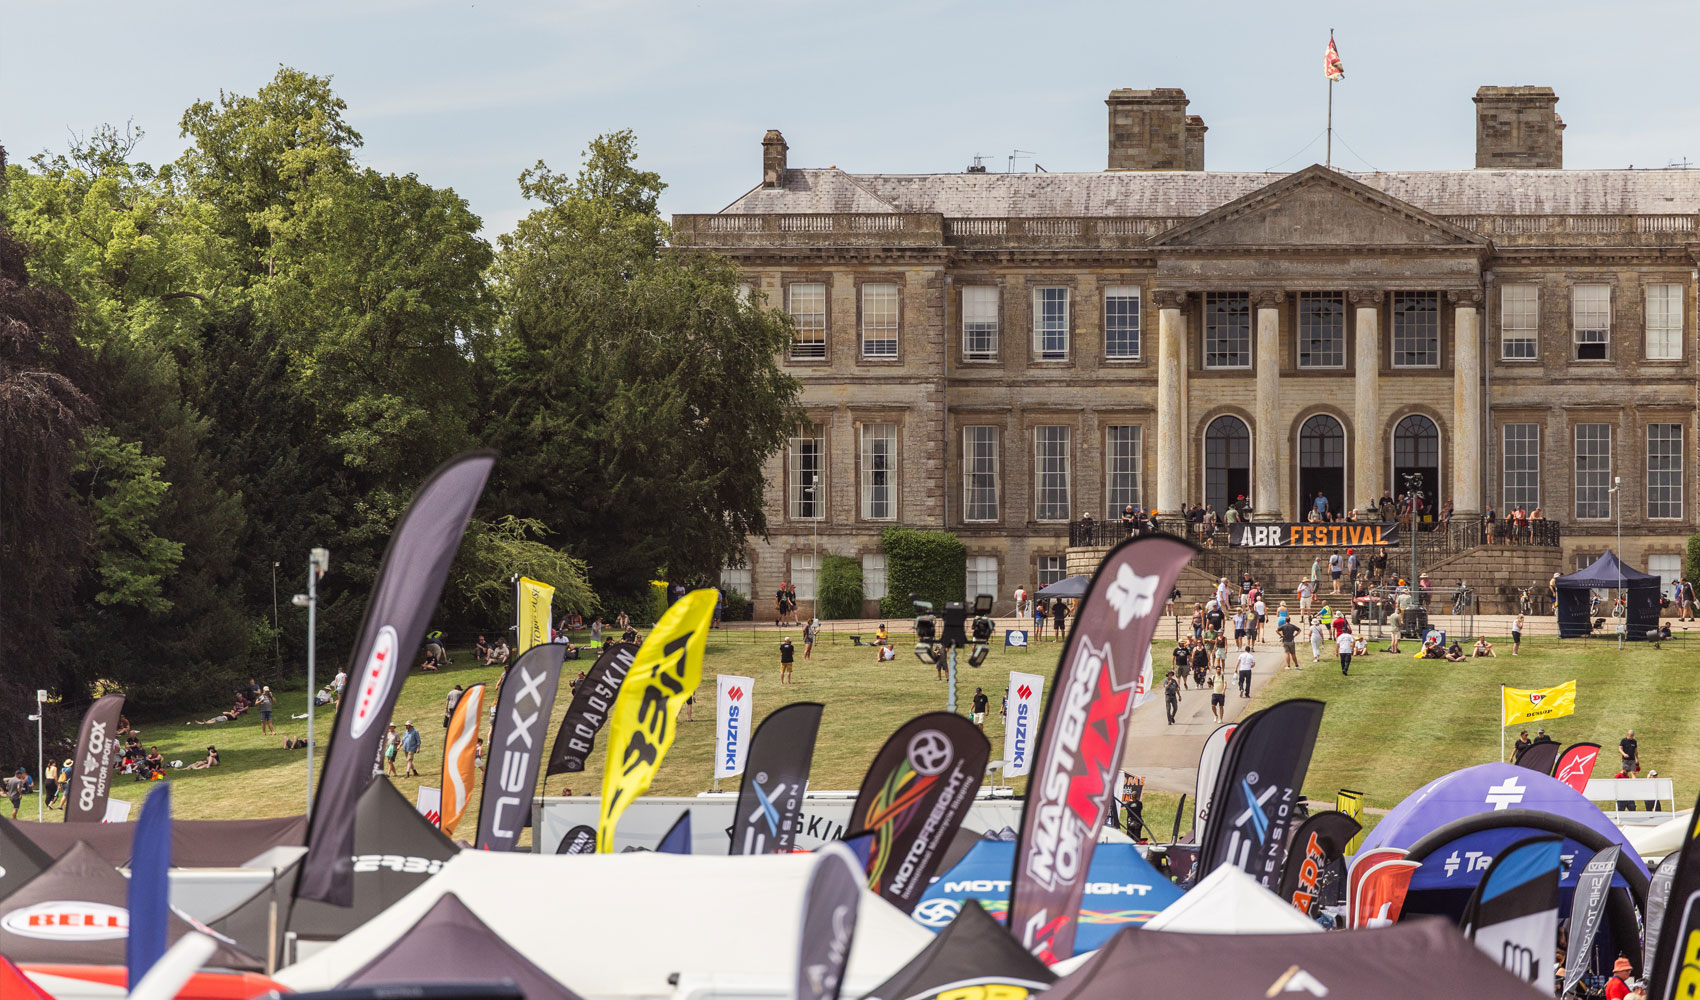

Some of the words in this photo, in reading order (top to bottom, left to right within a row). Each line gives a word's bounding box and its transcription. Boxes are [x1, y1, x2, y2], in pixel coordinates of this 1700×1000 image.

[1241, 526, 1281, 546] ABR
[1290, 525, 1388, 546] FESTIVAL
[568, 648, 636, 753] ROADSKIN
[1526, 709, 1553, 718] DUNLOP
[101, 737, 113, 765] SPORT
[725, 705, 740, 771] SUZUKI
[1013, 703, 1028, 769] SUZUKI
[1031, 652, 1102, 883] MASTERS
[97, 766, 109, 797] MOTOR
[889, 764, 965, 896] MOTOFREIGHT
[1055, 805, 1080, 881] OF
